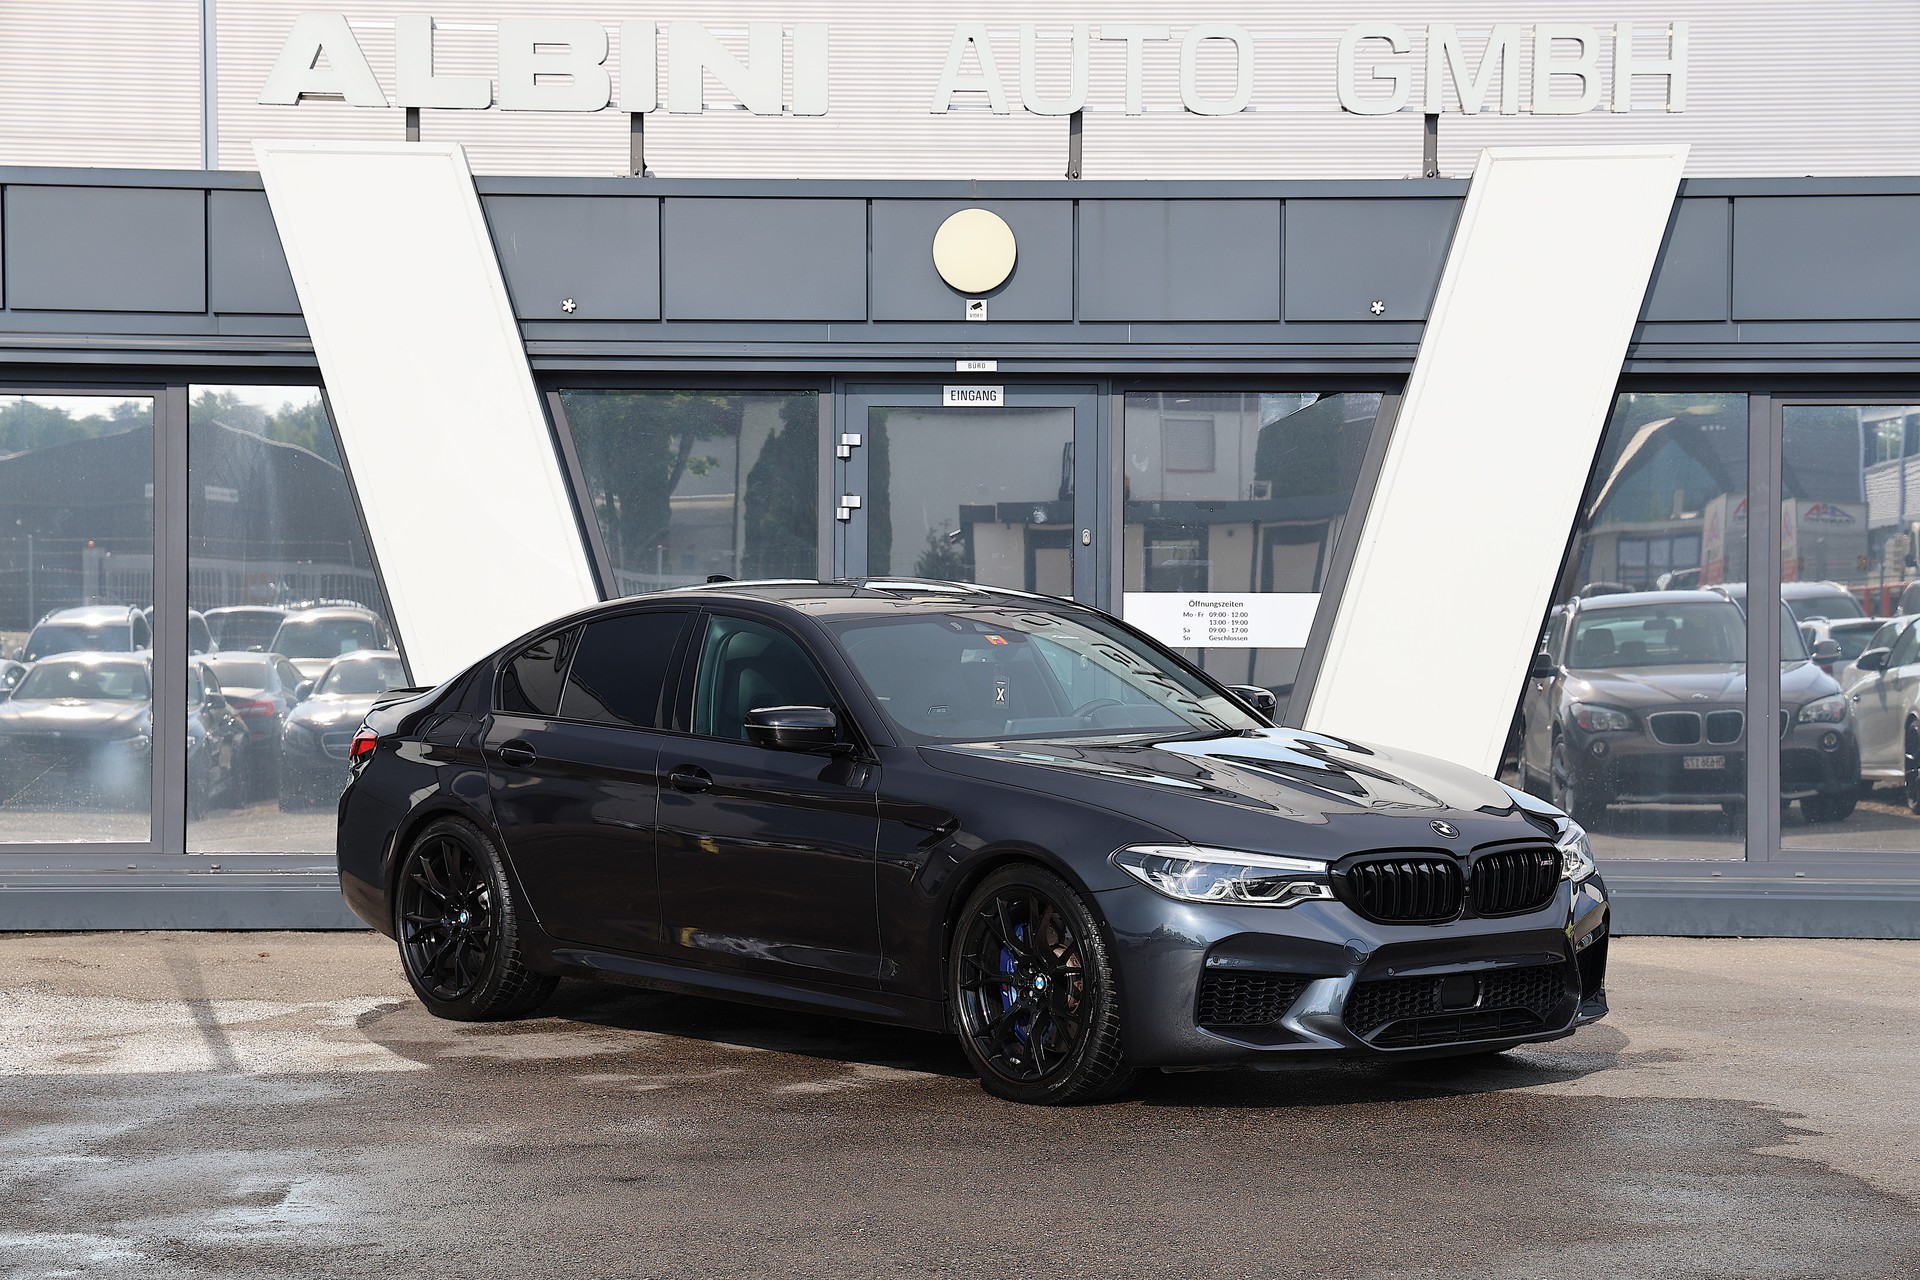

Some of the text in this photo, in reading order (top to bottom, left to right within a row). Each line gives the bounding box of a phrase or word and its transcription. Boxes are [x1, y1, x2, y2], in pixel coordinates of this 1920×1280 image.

[259, 12, 1690, 116] ALBINI AUTO GMBH
[968, 362, 986, 370] BÜRO
[951, 390, 997, 401] EINGANG
[1189, 599, 1243, 608] Öffnungszeiten
